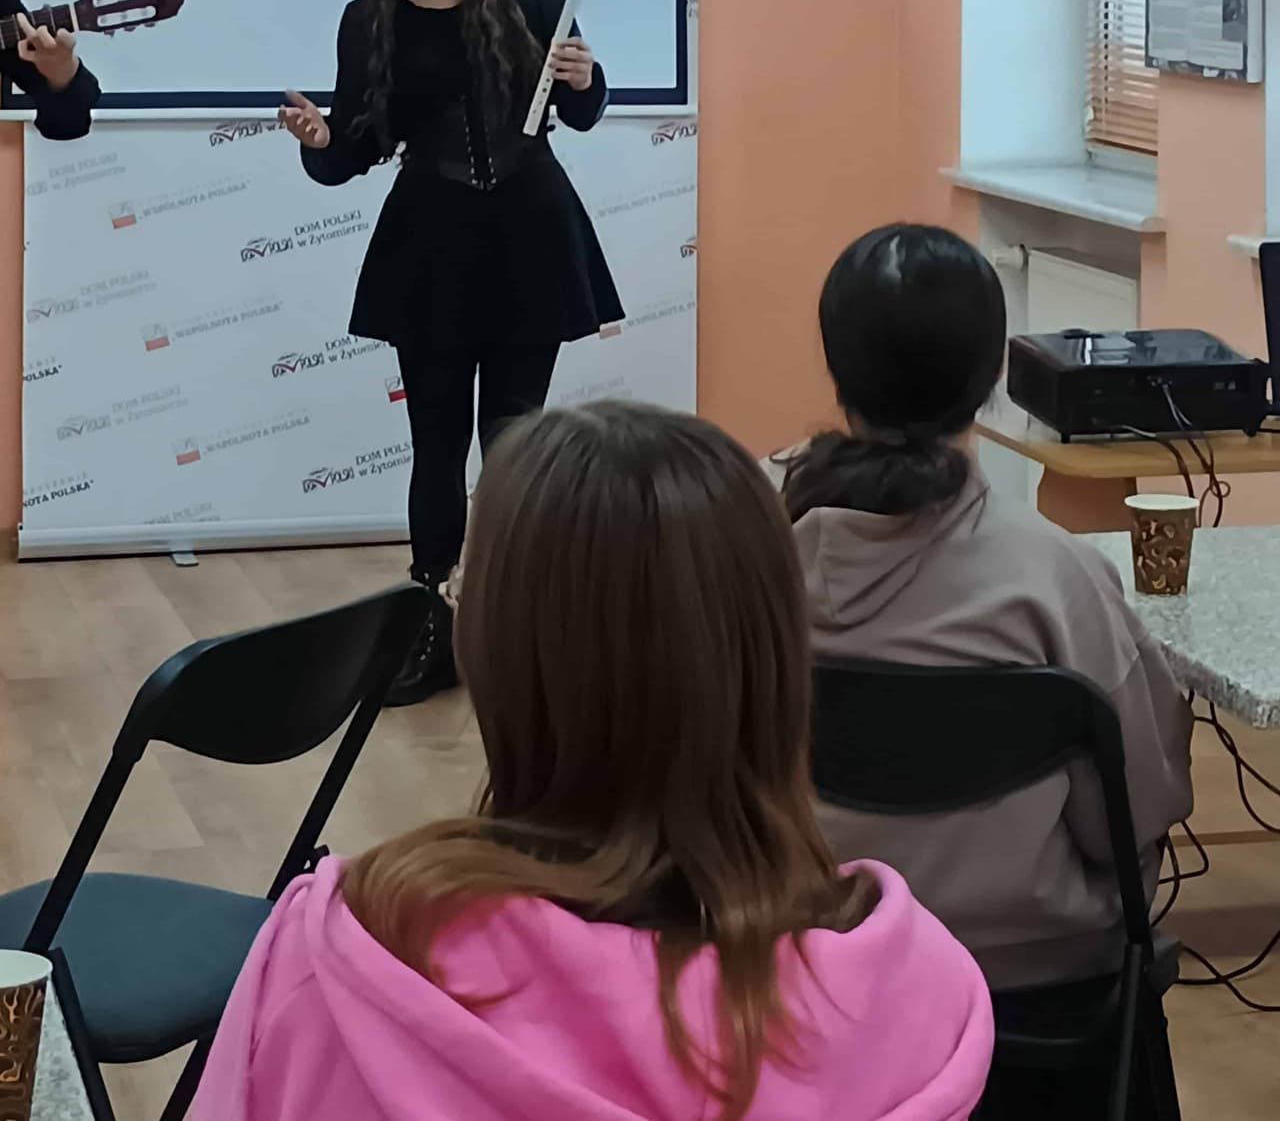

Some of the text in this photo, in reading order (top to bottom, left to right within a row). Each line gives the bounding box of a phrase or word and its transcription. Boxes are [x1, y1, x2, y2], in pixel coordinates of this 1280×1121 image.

[294, 209, 362, 236] DOM POLSKI
[356, 440, 411, 465] DOM POLS
